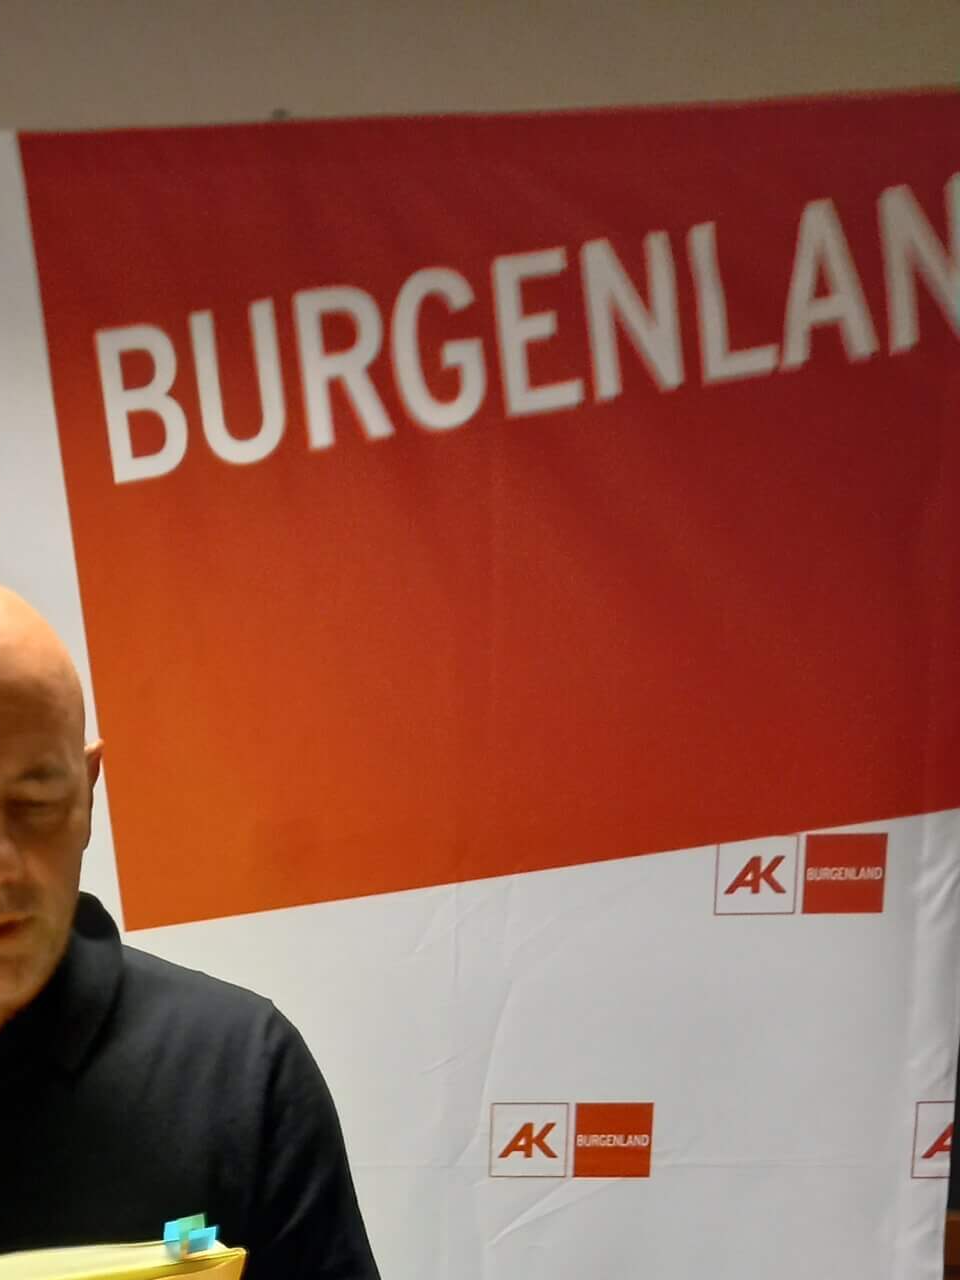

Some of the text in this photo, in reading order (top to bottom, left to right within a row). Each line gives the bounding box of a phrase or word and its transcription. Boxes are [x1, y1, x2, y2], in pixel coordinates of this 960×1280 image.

[723, 855, 883, 894] AK BURGENLAND
[498, 1122, 649, 1158] AK BURGENLAND
